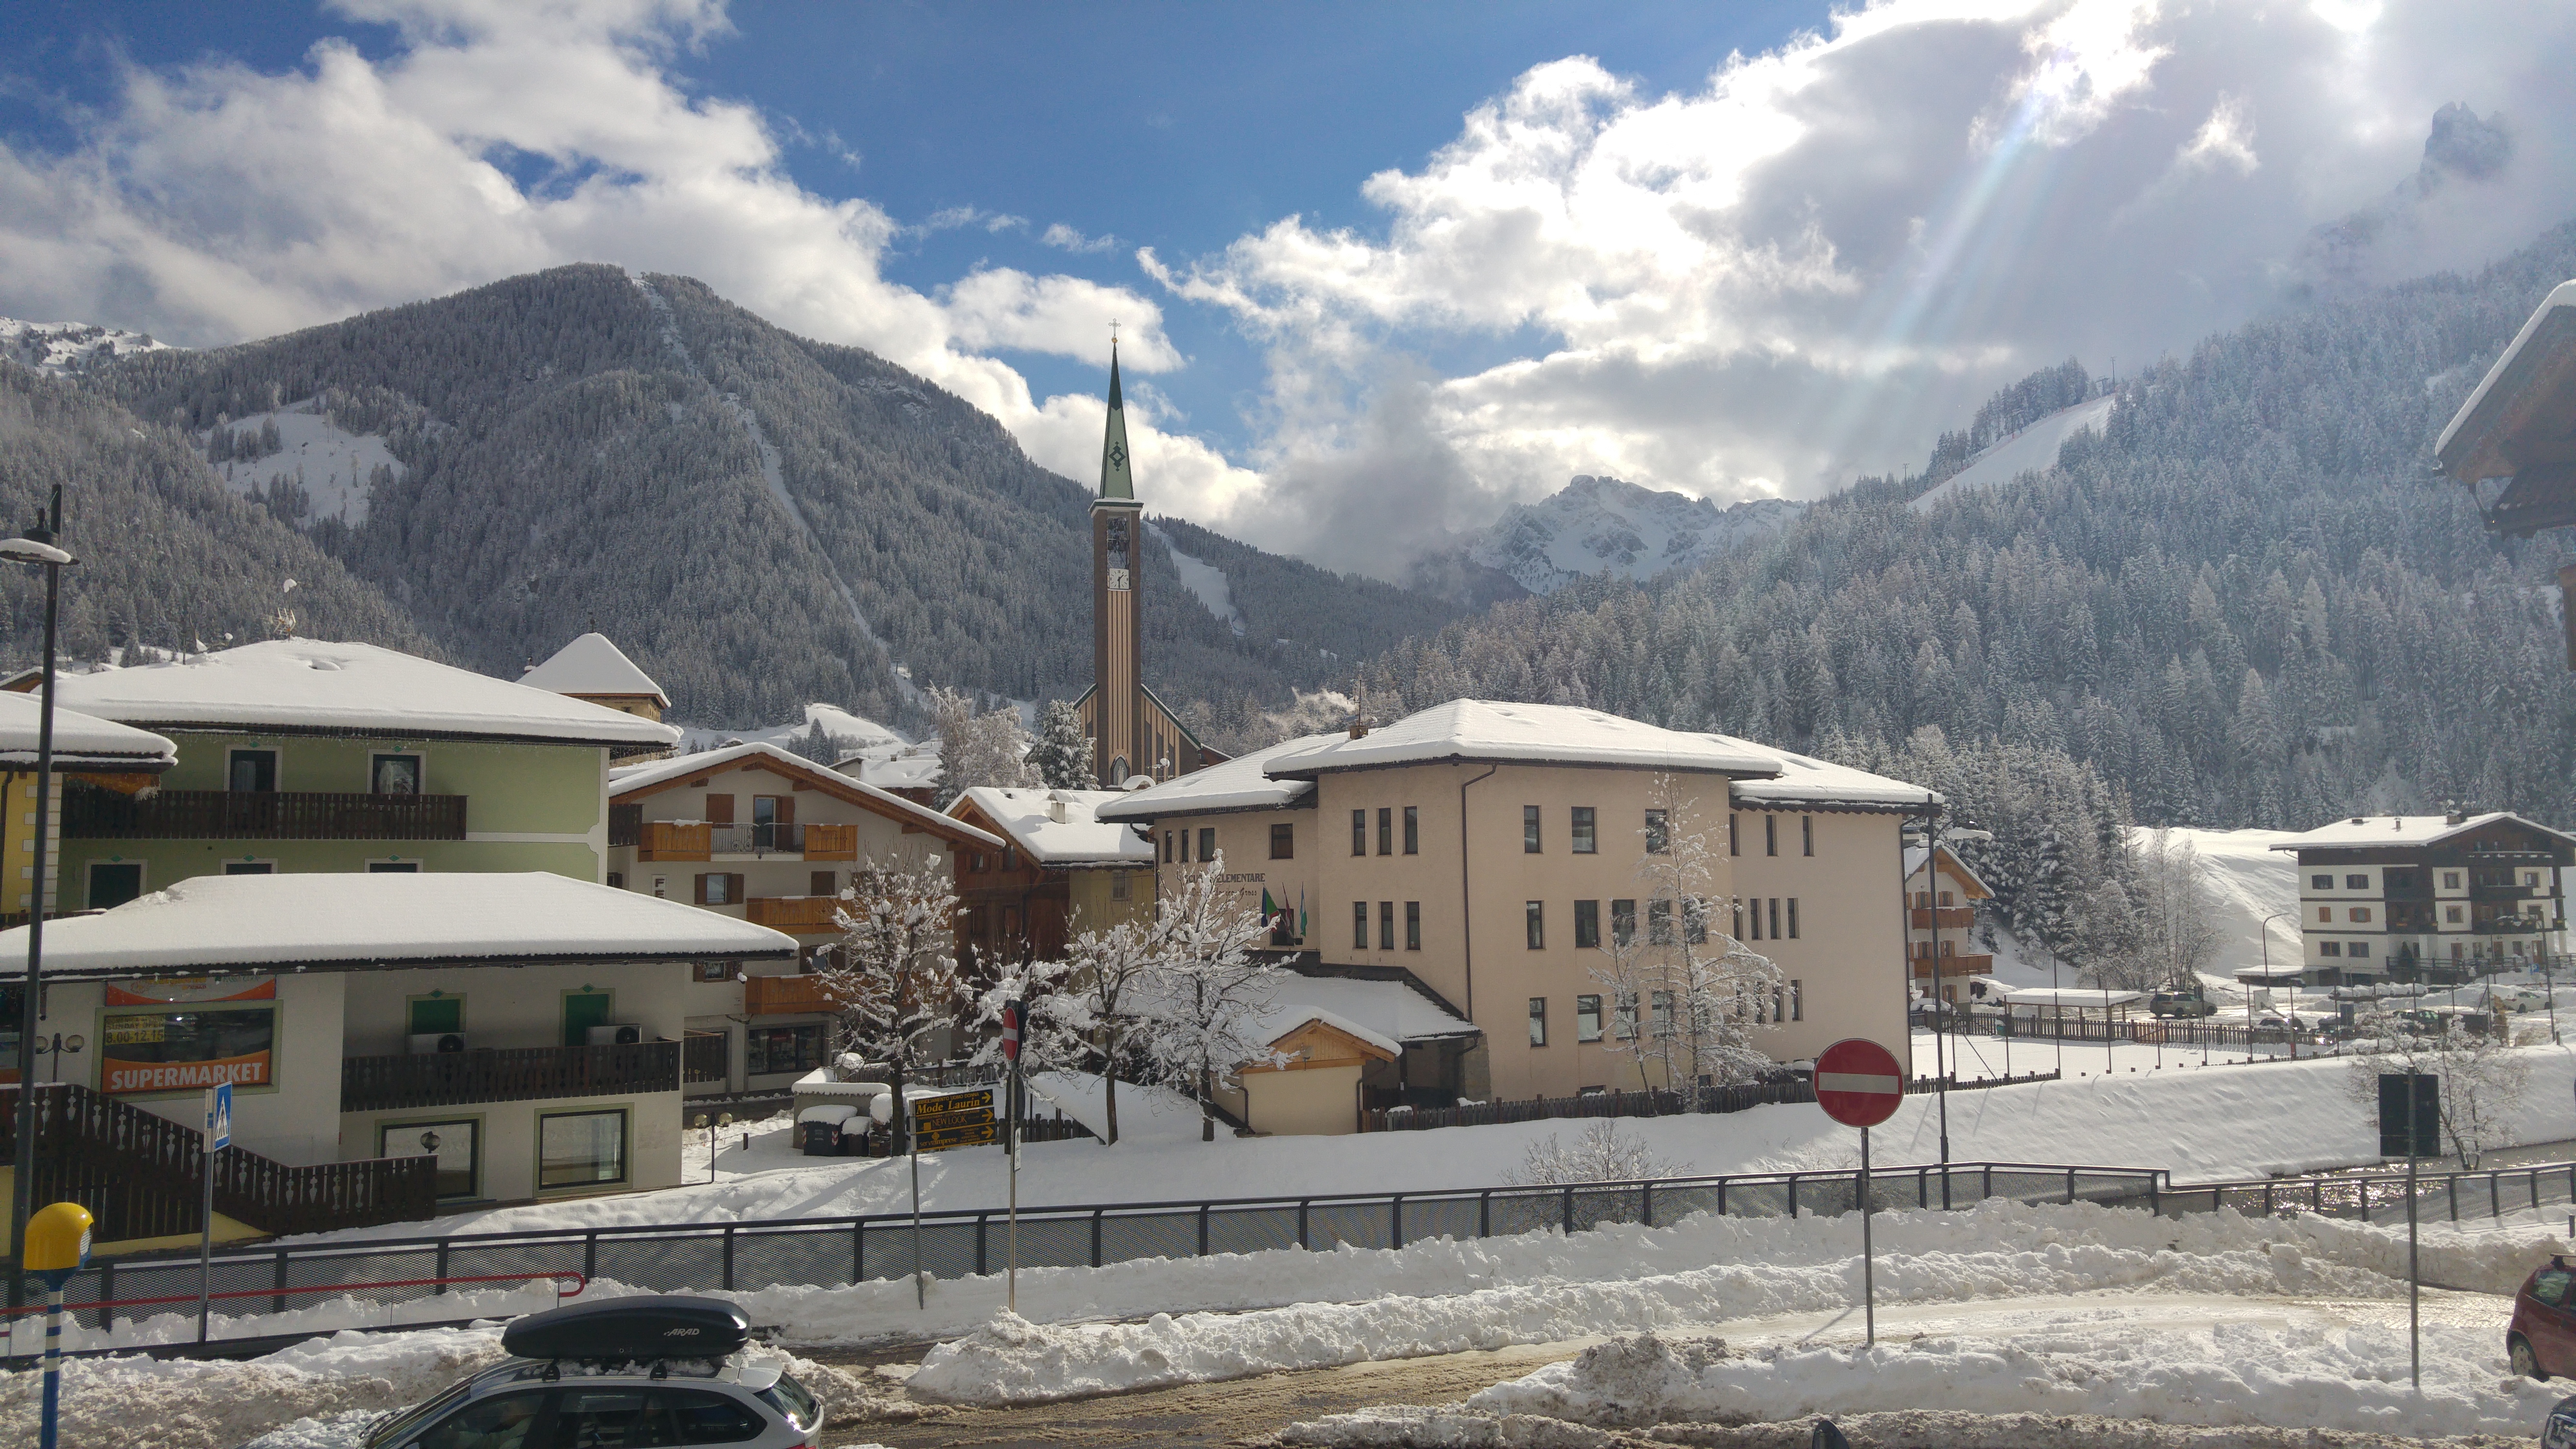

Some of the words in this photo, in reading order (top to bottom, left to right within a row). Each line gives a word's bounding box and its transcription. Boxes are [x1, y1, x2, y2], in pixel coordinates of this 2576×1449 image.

[1216, 873, 1265, 883] ELEMENTARE
[111, 1062, 262, 1090] SUPERMARKET
[916, 1102, 944, 1114] Mode
[948, 1097, 980, 1110] Laurin
[932, 1118, 947, 1127] NEW
[948, 1115, 967, 1125] LOOK
